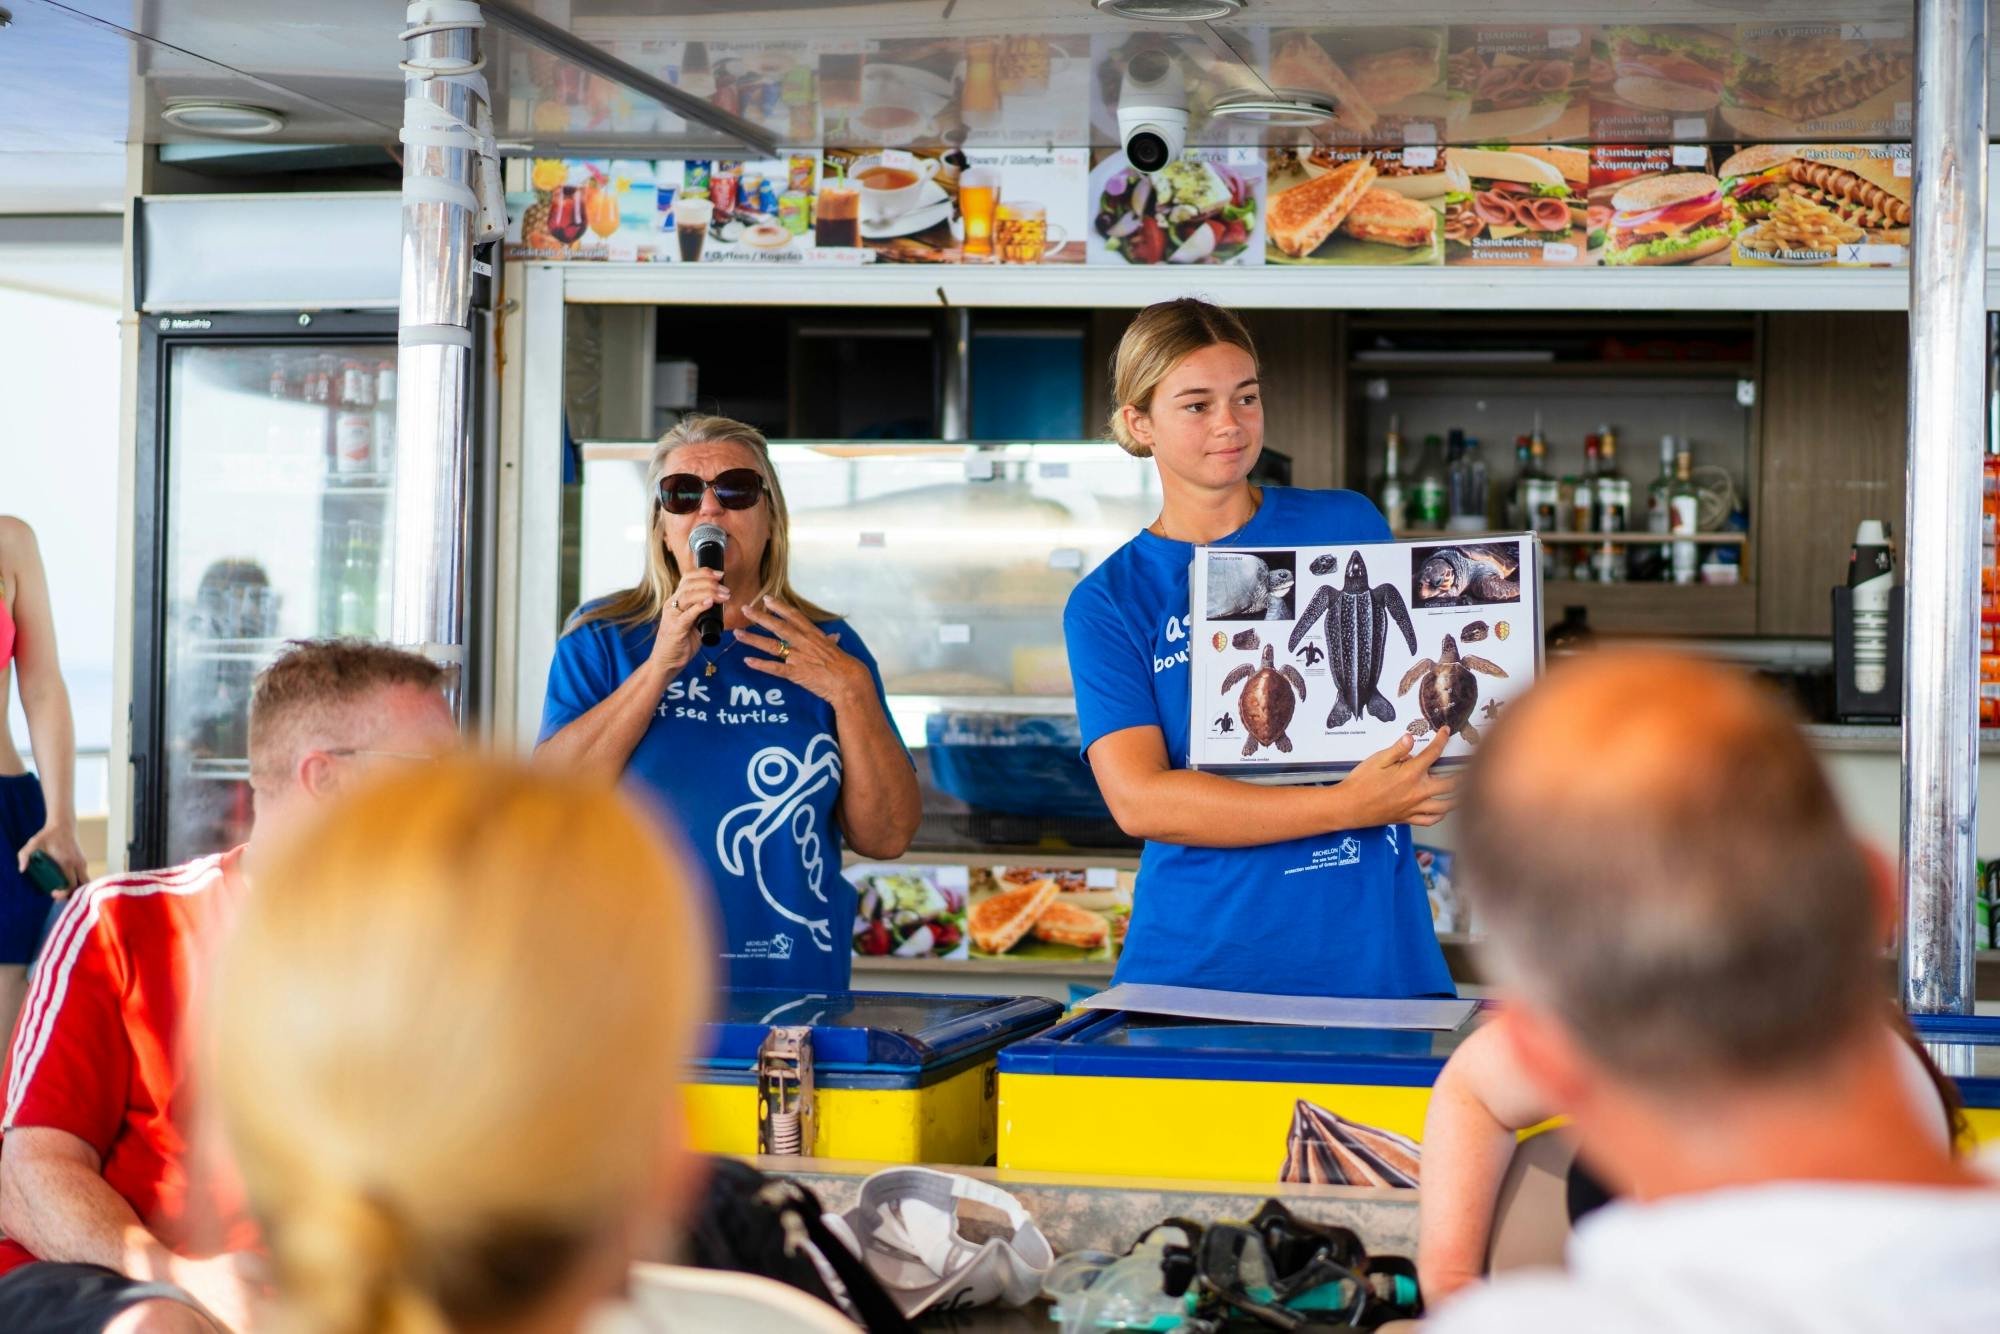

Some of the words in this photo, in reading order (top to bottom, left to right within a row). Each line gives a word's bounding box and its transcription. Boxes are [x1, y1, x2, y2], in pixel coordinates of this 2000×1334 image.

[1329, 150, 1361, 160] Toast
[1596, 147, 1671, 159] Hamburgers
[1806, 149, 1828, 159] Hot
[1832, 149, 1855, 160] Dog
[1472, 237, 1543, 248] Sandwiches
[1738, 249, 1770, 260] Chips
[663, 677, 711, 702] sk
[730, 685, 785, 706] me
[675, 706, 708, 721] sea
[716, 708, 789, 724] turtles
[1312, 848, 1339, 857] ARCHELON
